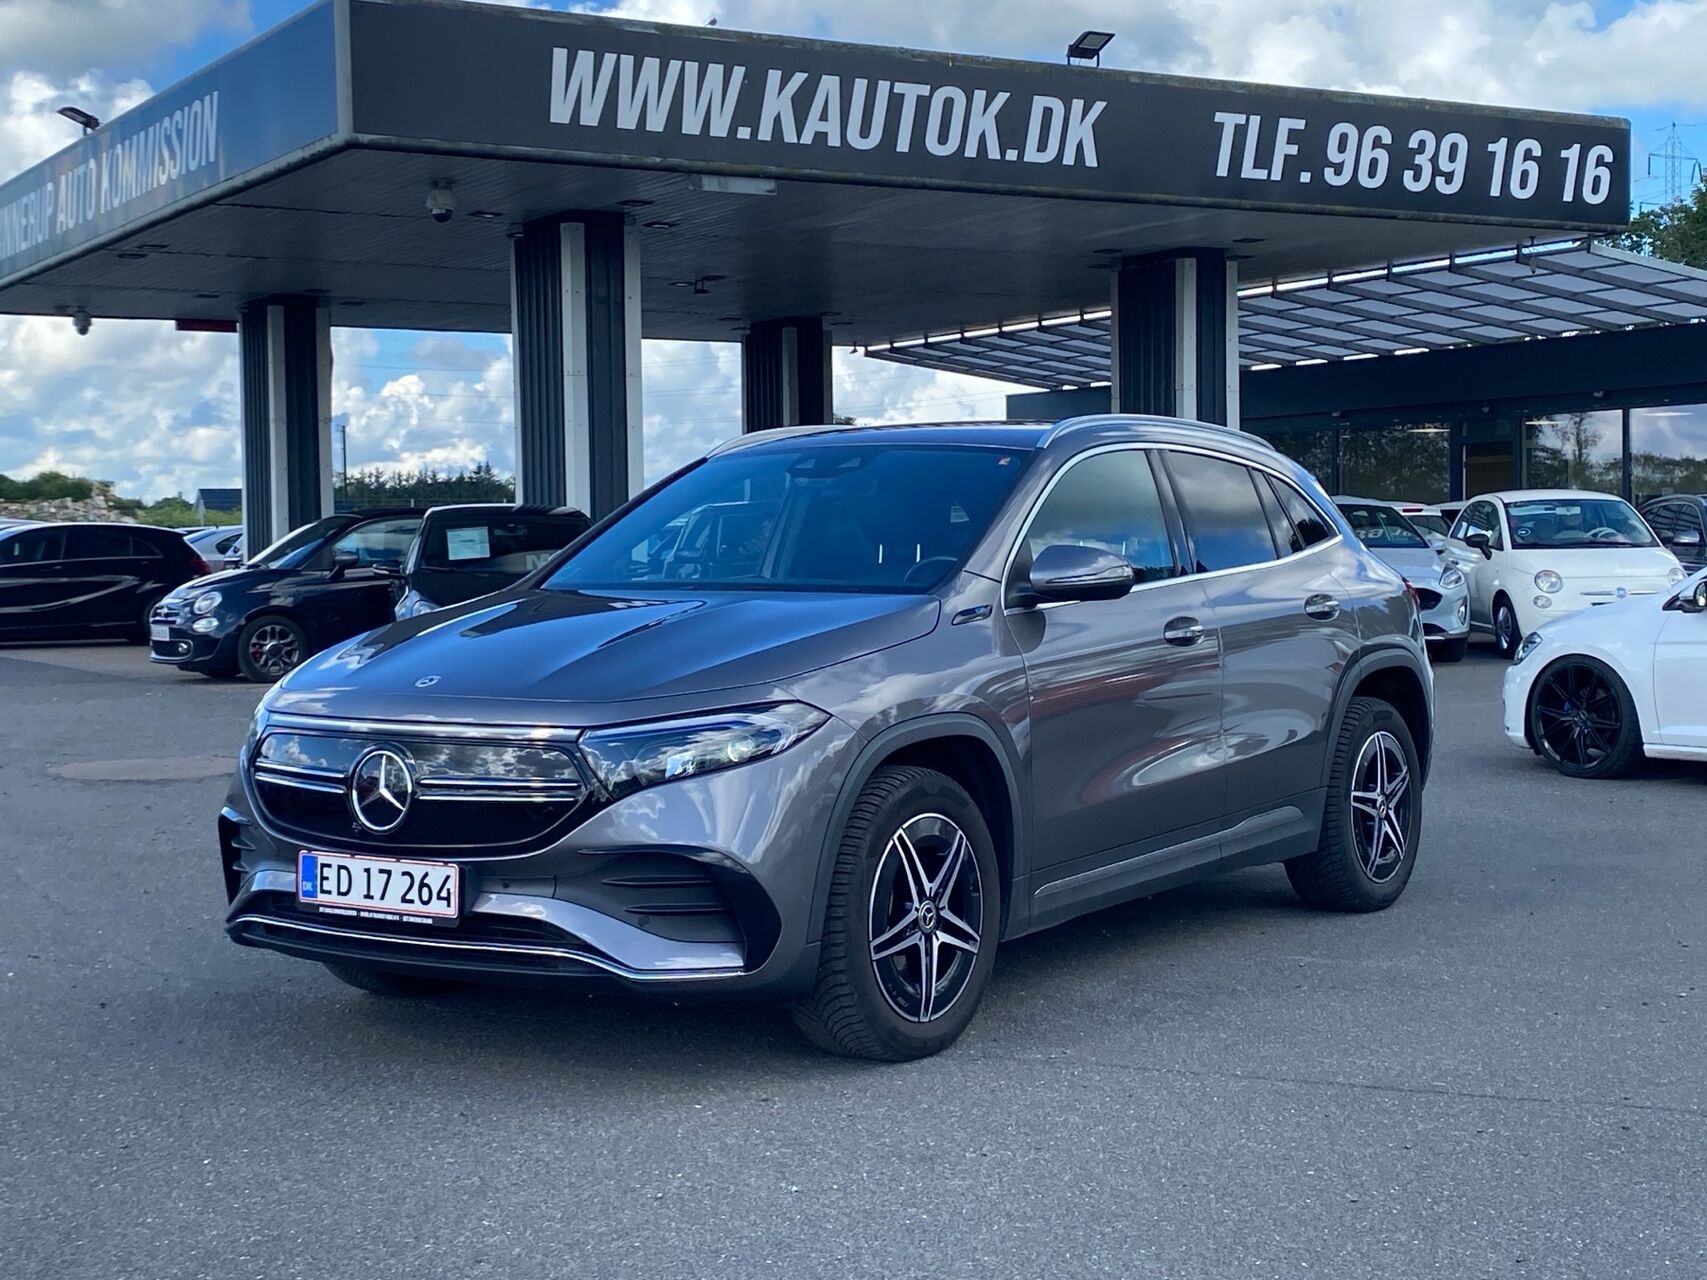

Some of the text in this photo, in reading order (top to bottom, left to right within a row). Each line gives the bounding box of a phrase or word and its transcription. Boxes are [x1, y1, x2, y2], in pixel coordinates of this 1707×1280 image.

[549, 46, 1108, 168] WWW.KAUTOK.DK
[56, 158, 97, 234] AUTO
[100, 91, 219, 214] KOMMISSION
[1213, 111, 1614, 205] TLF. 96 39 16 16
[302, 881, 314, 891] DK
[319, 862, 452, 908] ED 17 264
